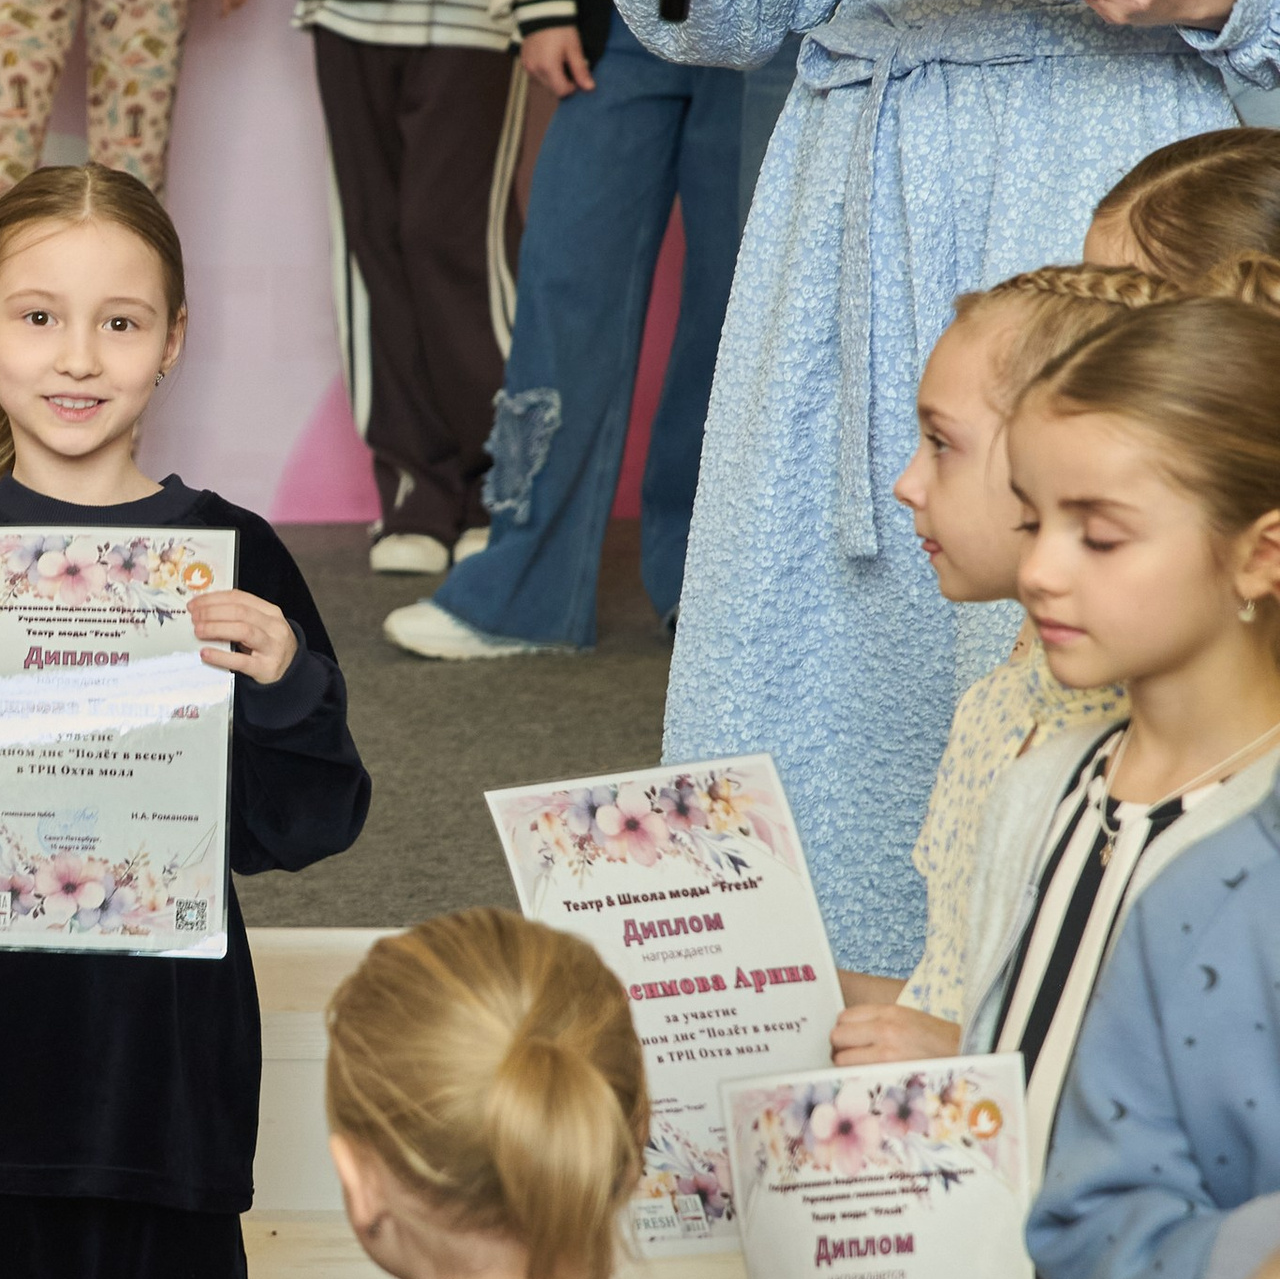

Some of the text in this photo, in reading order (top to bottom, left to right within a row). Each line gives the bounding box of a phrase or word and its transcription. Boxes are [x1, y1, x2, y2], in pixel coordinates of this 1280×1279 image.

[23, 645, 130, 670] Диплом
[563, 899, 604, 913] Театр
[605, 896, 616, 908] &
[619, 890, 667, 906] Школа
[669, 885, 710, 899] моды
[623, 912, 725, 948] Диплом
[641, 942, 723, 964] награждается
[623, 963, 817, 1001] симова Арина
[815, 1233, 915, 1269] Диплом
